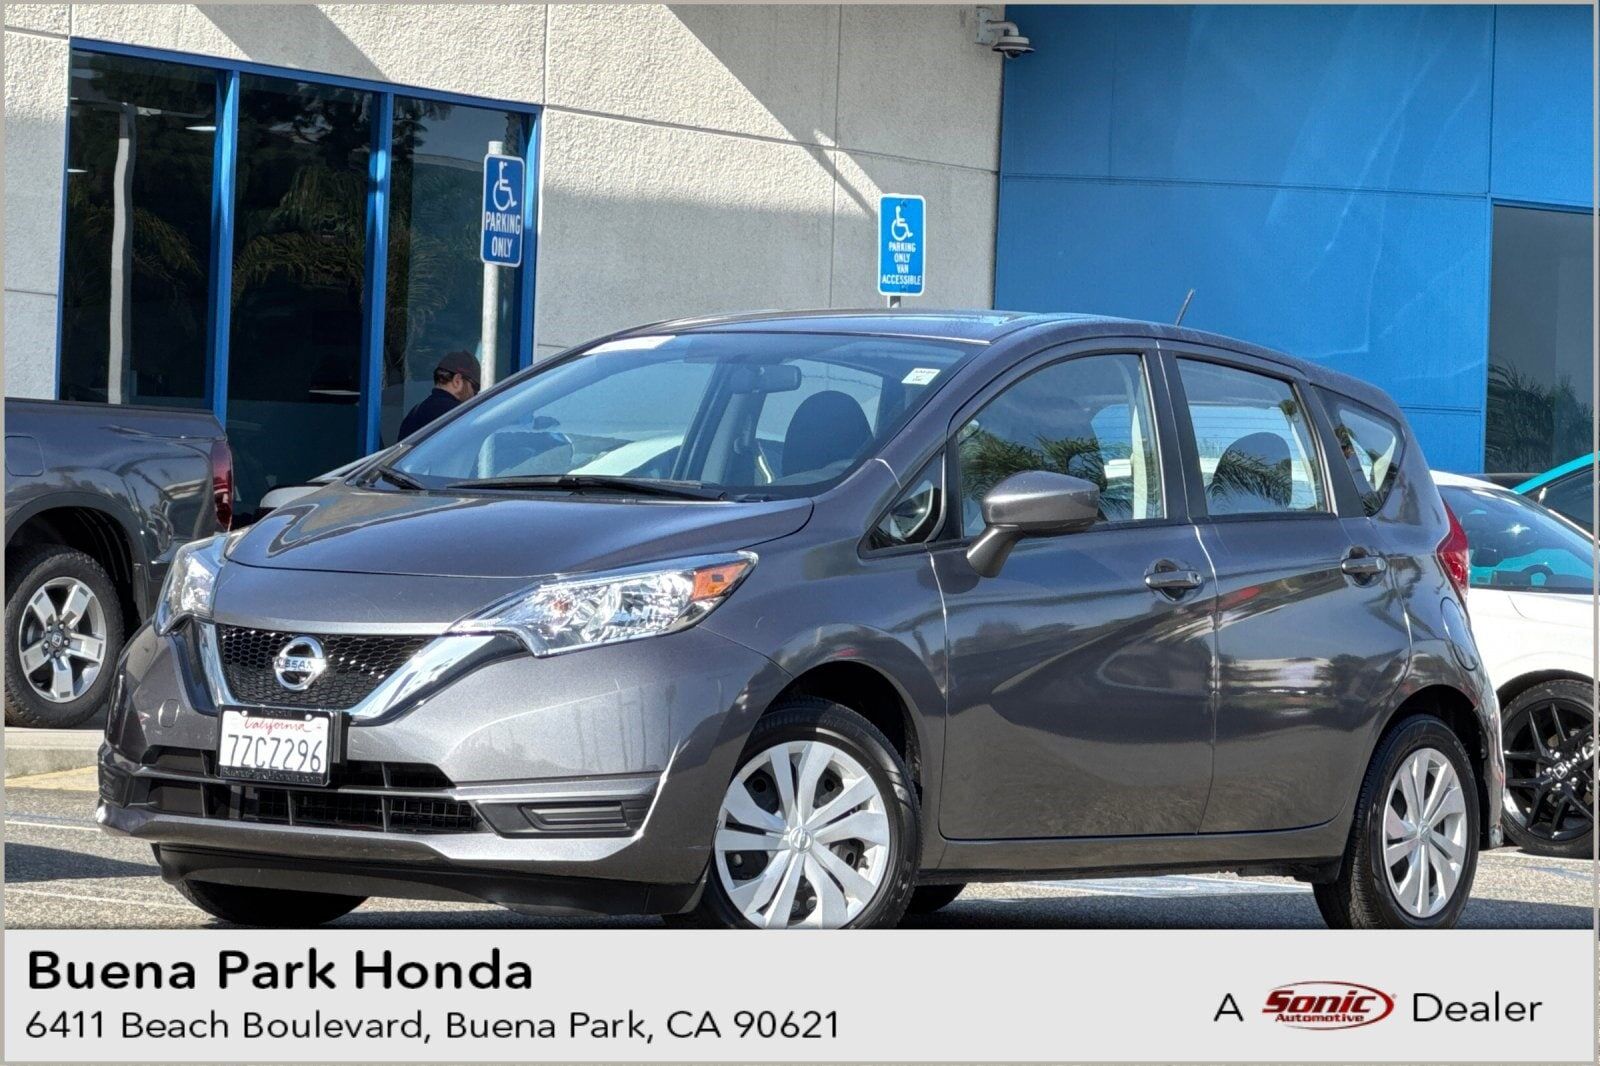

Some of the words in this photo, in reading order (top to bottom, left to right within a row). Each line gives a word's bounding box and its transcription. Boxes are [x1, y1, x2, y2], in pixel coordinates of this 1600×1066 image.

[485, 211, 520, 234] PARKING
[491, 236, 513, 258] ONLY
[888, 241, 916, 252] PARKING
[894, 253, 910, 263] ONLY
[896, 263, 909, 275] VAN
[881, 274, 922, 286] ACCESSIBLE
[276, 657, 314, 669] SSAN
[244, 717, 312, 734] California
